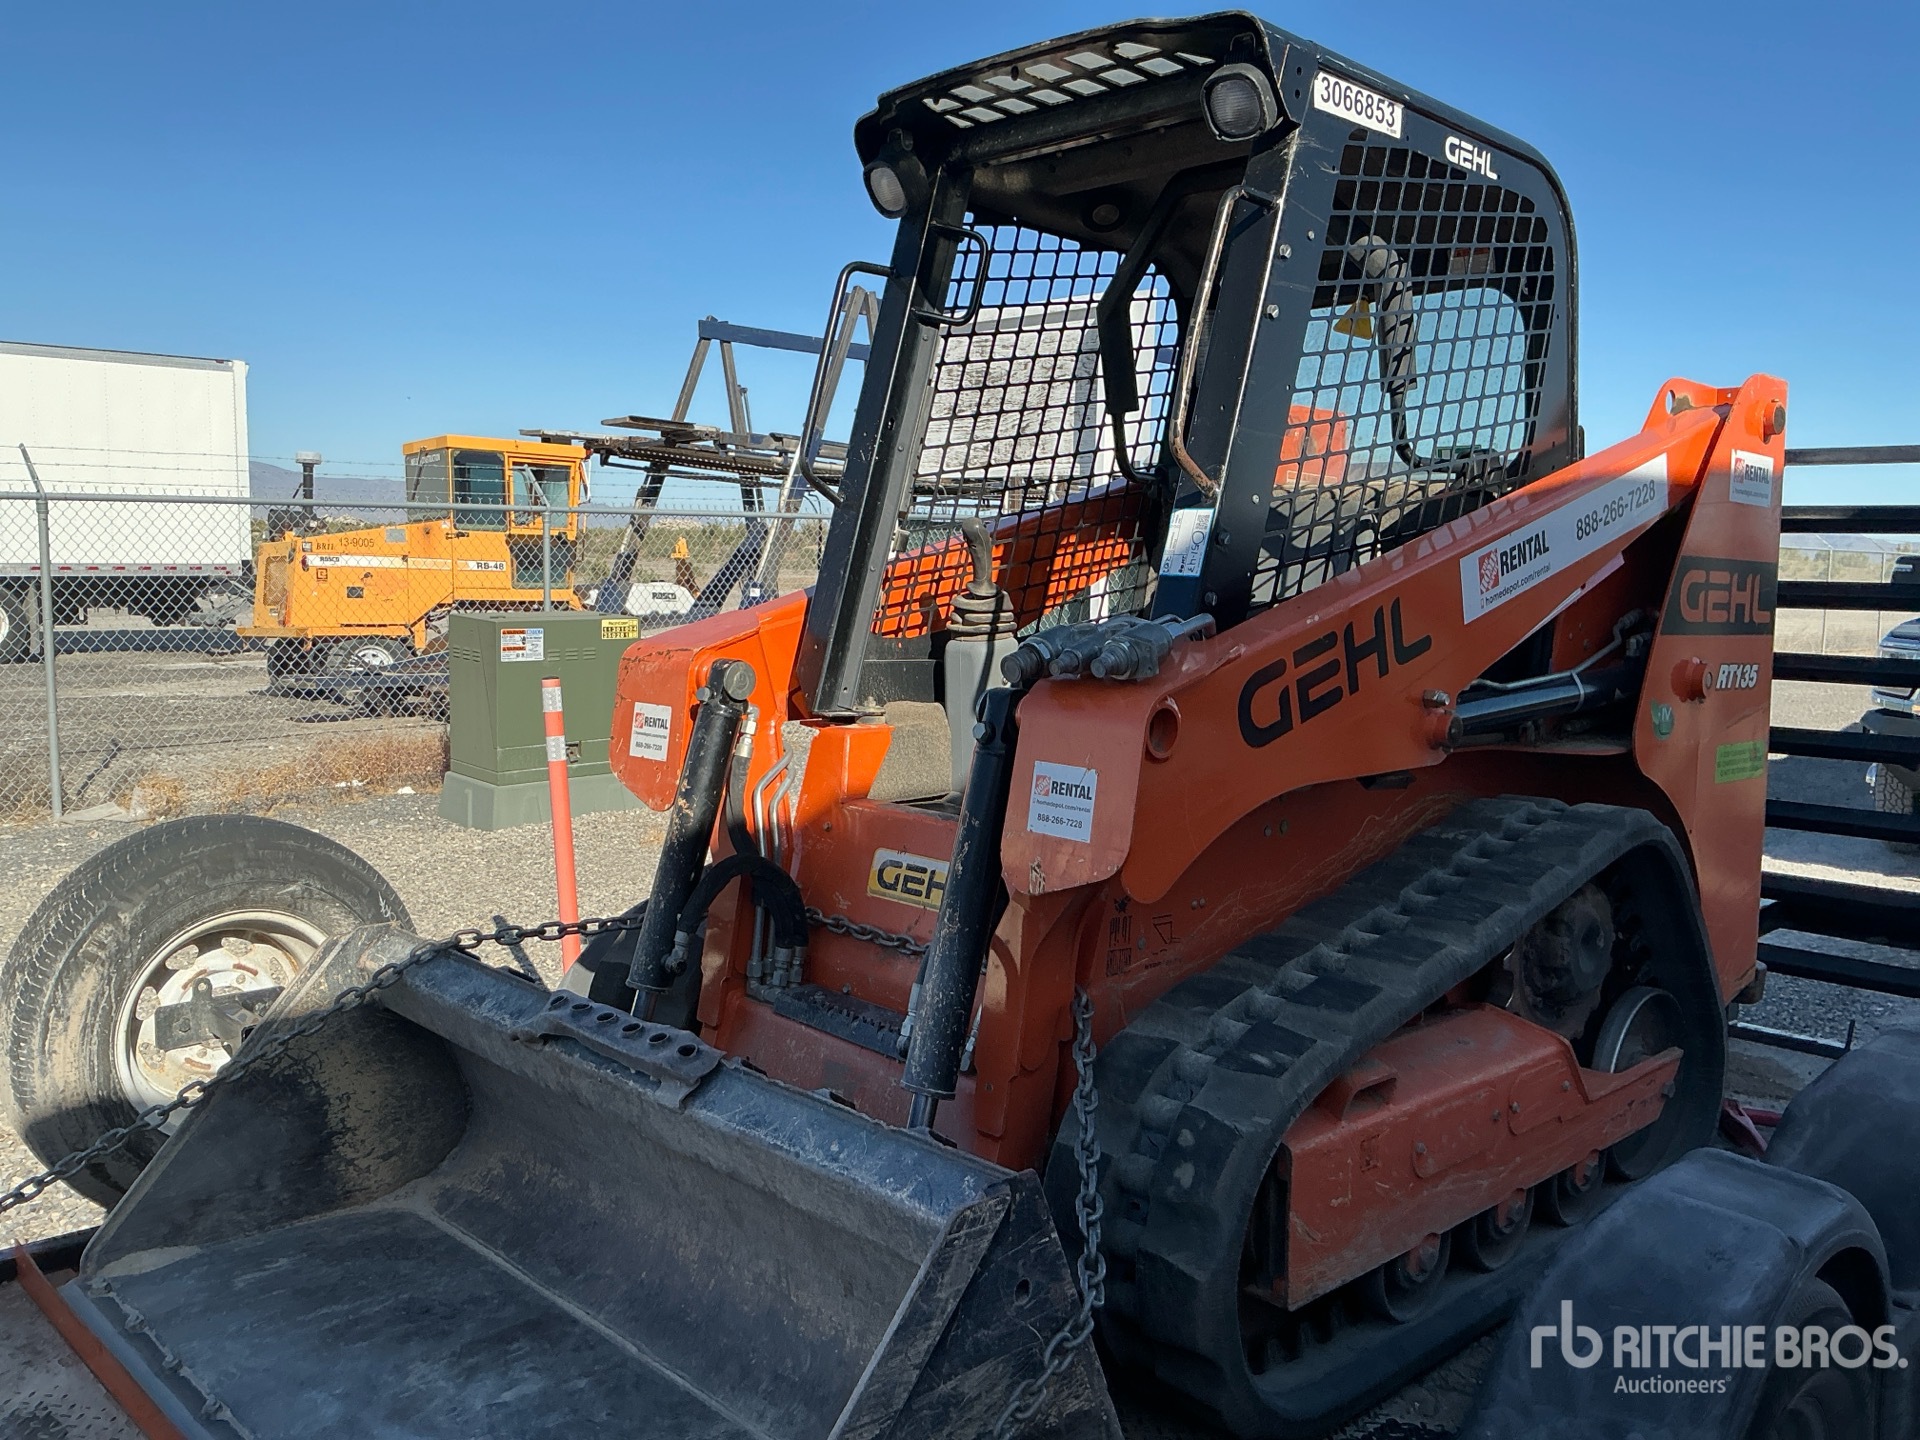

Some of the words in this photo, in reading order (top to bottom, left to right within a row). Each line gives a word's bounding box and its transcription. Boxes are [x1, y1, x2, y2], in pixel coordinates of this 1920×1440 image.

[1320, 76, 1395, 128] 3066853
[1445, 136, 1497, 180] GEHL
[1744, 464, 1770, 484] RENTAL
[1576, 480, 1656, 541] 888-266-7228
[339, 537, 374, 547] 13-9005
[1500, 530, 1550, 576] RENTAL
[476, 562, 504, 570] RB-48
[1485, 563, 1551, 606] homedepot.com/rental
[1680, 569, 1770, 624] GEHL
[1237, 597, 1433, 749] GEHL
[1715, 664, 1759, 690] RT135
[644, 716, 668, 730] RENTAL
[1051, 780, 1092, 800] RENTAL
[1037, 813, 1082, 829] 888-266-7228
[877, 859, 945, 899] GEH
